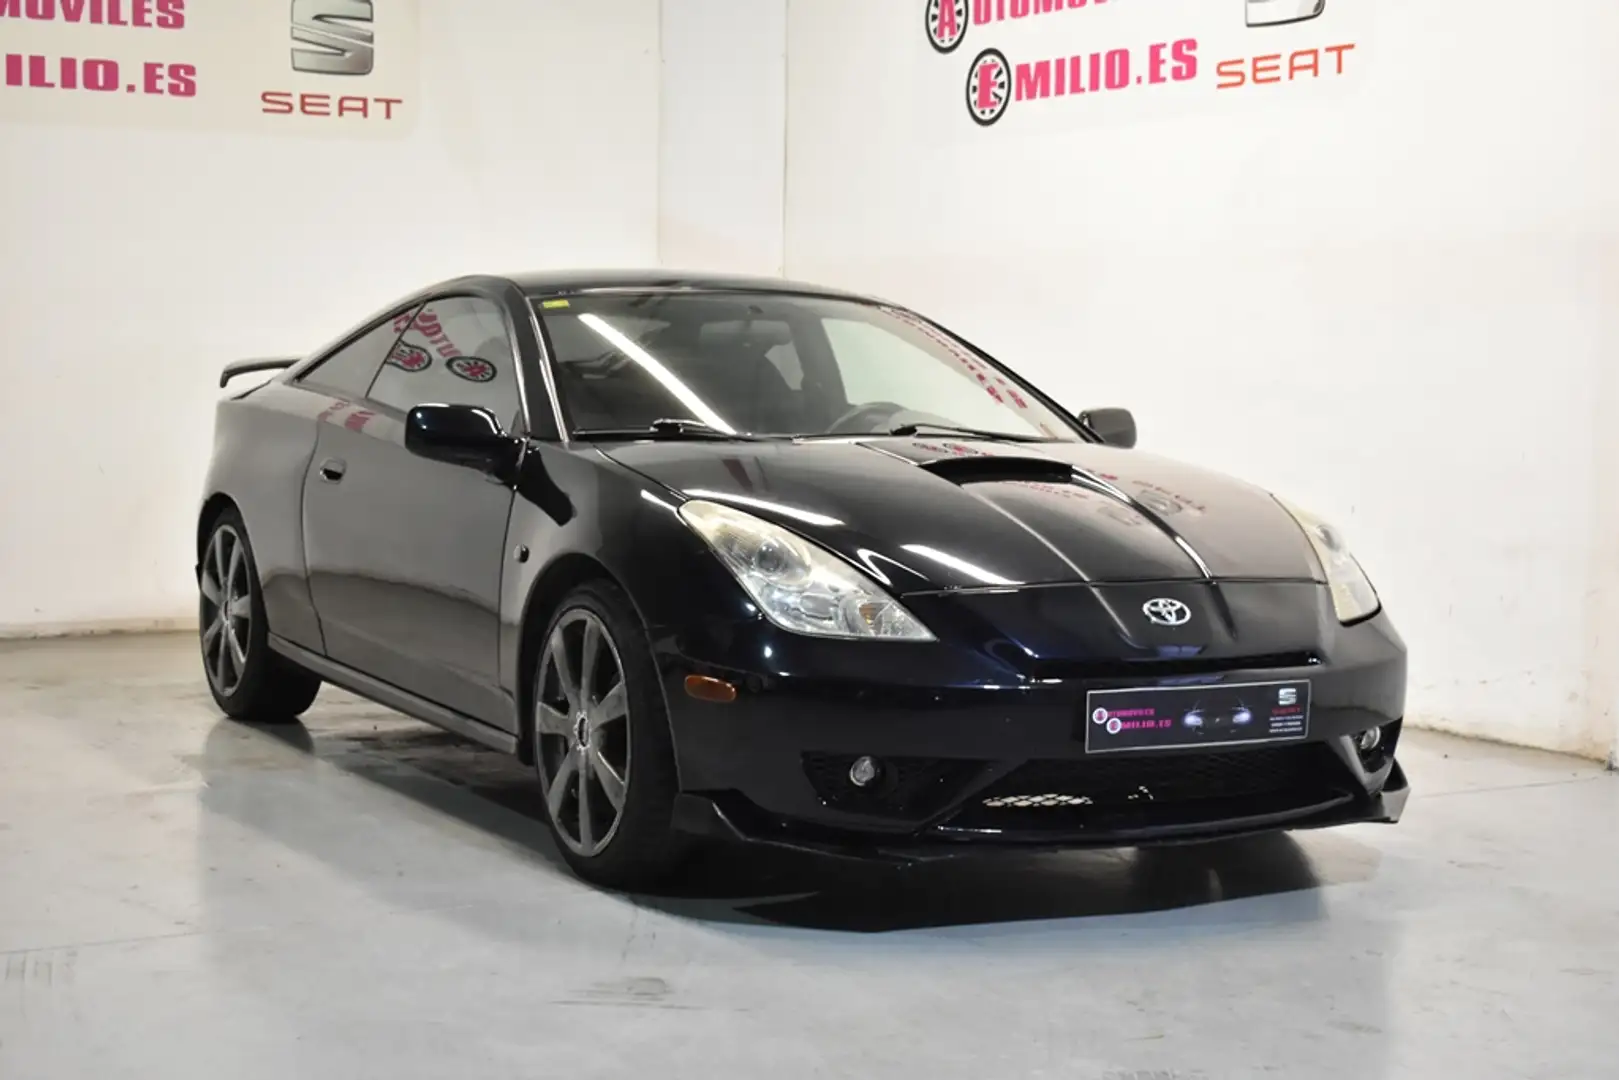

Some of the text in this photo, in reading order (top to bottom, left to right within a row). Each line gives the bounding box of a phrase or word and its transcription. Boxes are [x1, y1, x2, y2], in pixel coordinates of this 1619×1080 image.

[6, 54, 196, 97] ILIO.ES
[1217, 44, 1355, 88] SEAT
[262, 92, 402, 119] SEAT
